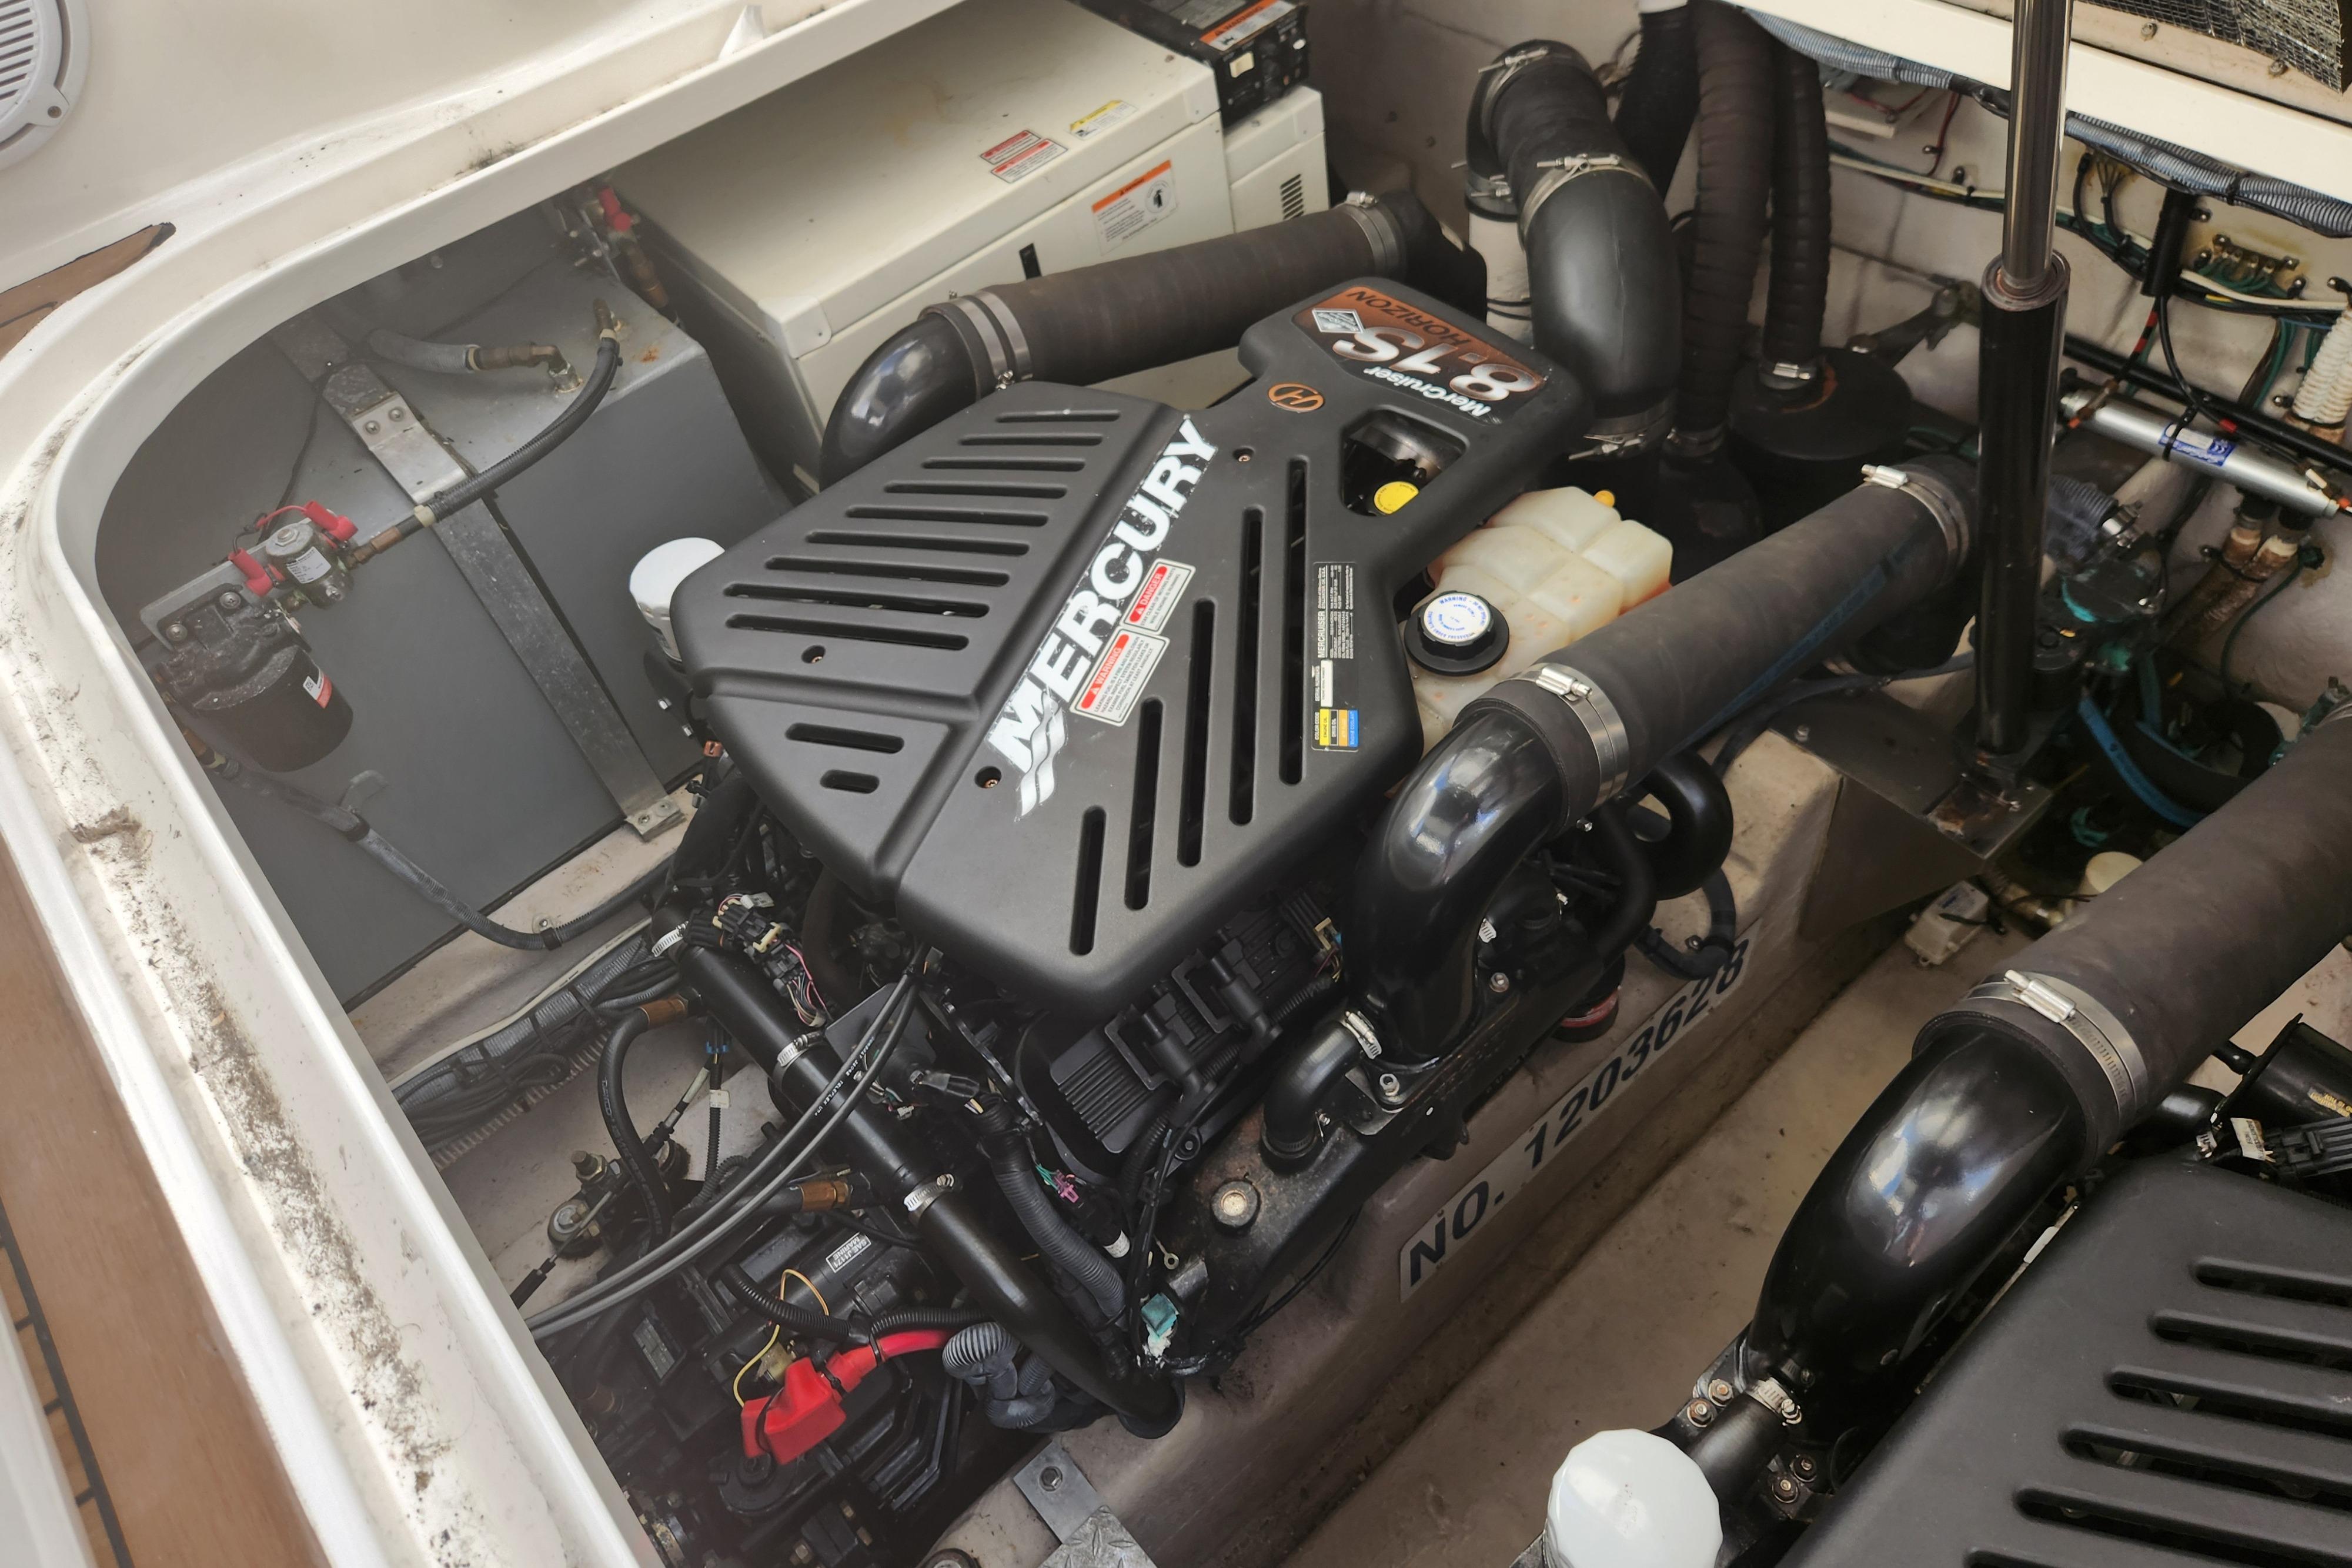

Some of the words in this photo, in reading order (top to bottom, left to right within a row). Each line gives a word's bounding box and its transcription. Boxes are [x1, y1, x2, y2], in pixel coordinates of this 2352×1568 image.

[1349, 290, 1471, 347] HORIZON
[1332, 327, 1538, 402] 8.1S
[1364, 366, 1492, 417] MerCruiser
[988, 418, 1217, 773] MERCURY
[1139, 573, 1165, 606] DANGER
[1439, 596, 1467, 604] WARNING
[1095, 647, 1123, 685] WARNING
[1411, 1181, 1505, 1288] NO.
[1524, 940, 1749, 1169] 1203628
[833, 1236, 860, 1261] MARINE
[834, 1250, 853, 1269] J1171
[851, 1239, 867, 1253] SAE
